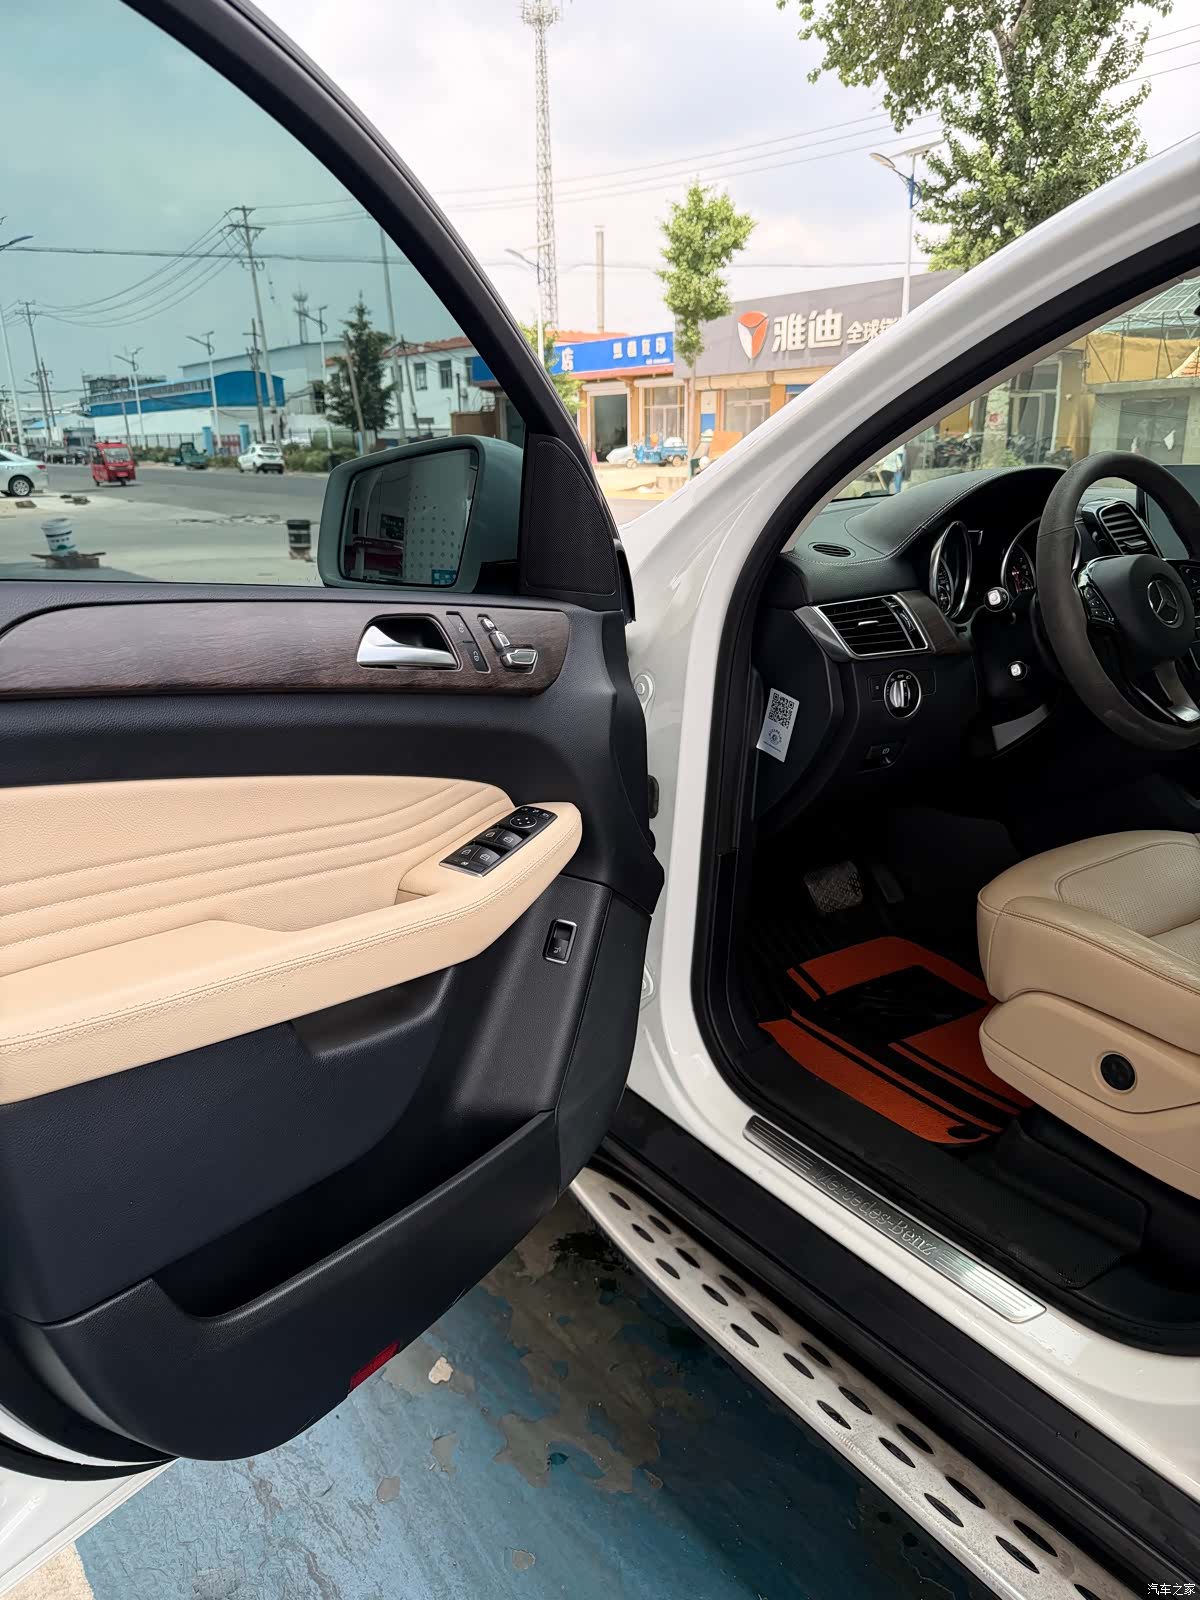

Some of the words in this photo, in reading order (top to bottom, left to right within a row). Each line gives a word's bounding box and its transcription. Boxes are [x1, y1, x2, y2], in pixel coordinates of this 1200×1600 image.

[771, 308, 843, 352] 雅迪
[561, 347, 574, 371] 店
[812, 1166, 937, 1256] Mercedes-Benz
